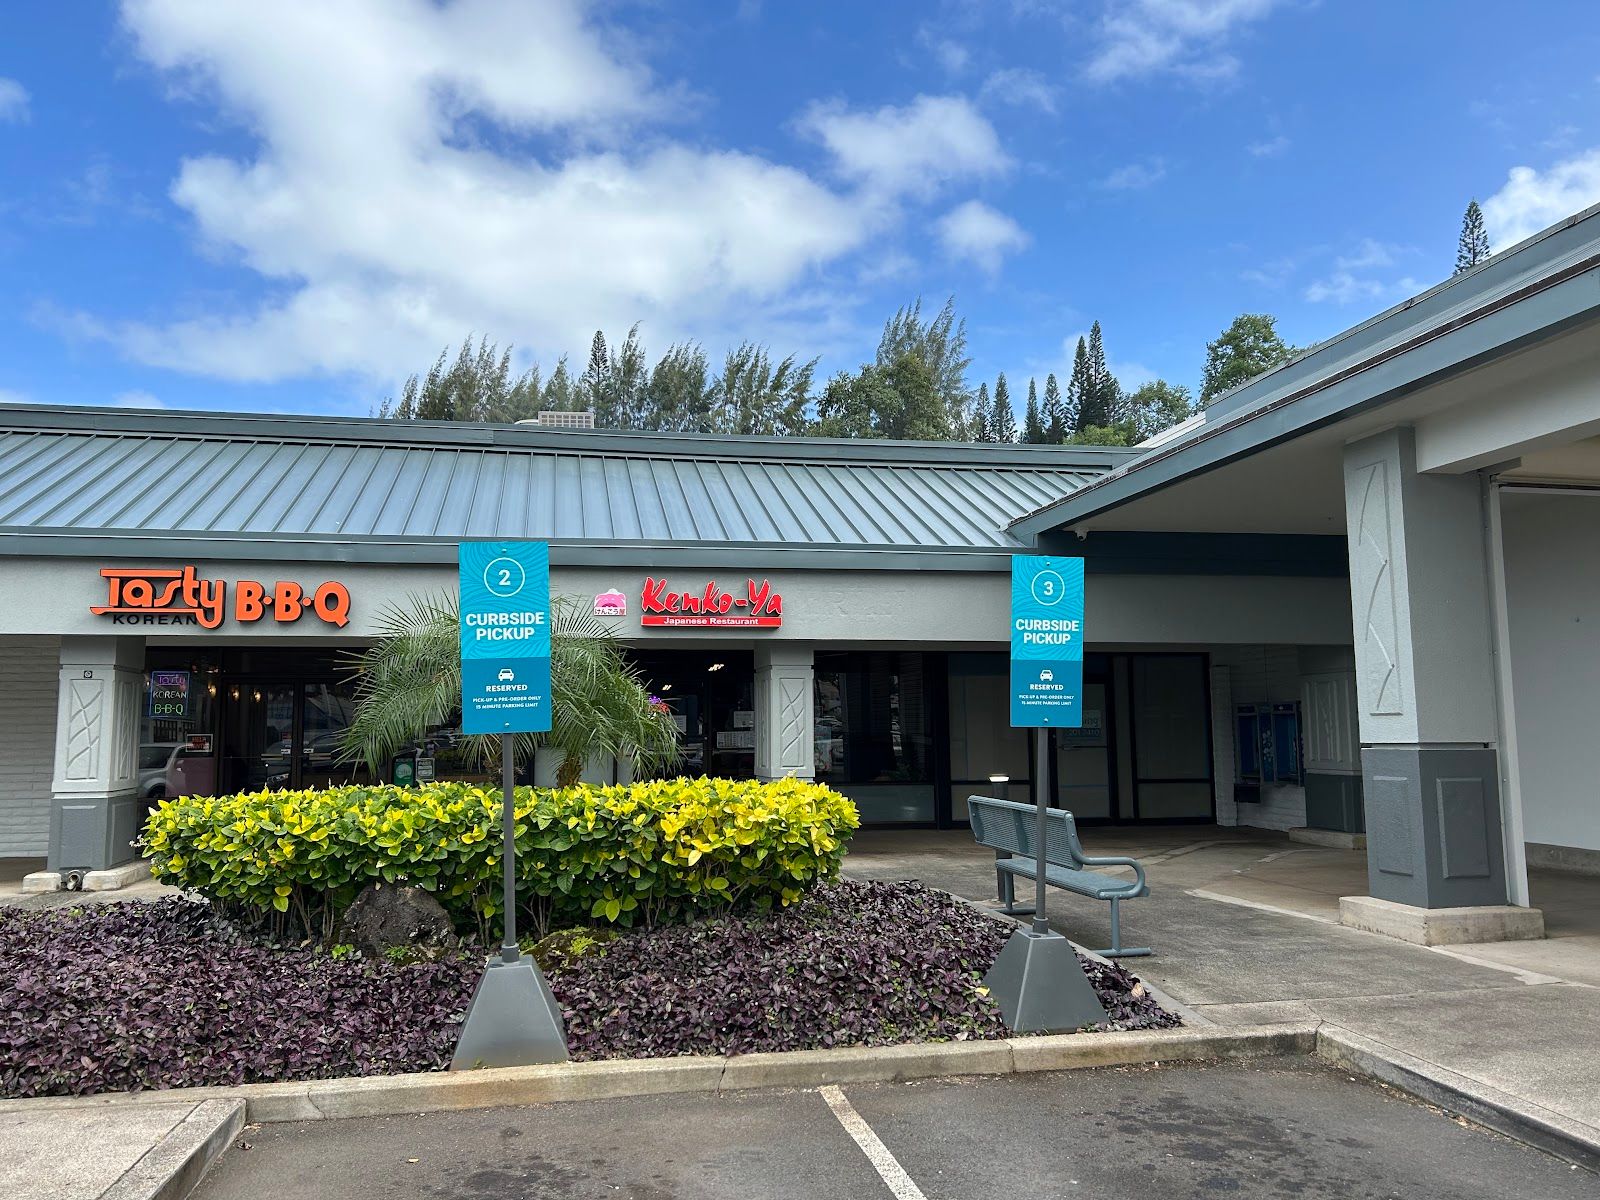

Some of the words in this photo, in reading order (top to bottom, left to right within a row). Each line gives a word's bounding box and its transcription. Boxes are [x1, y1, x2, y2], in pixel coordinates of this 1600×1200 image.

[498, 569, 511, 586] 2
[1043, 581, 1054, 596] 3
[90, 566, 225, 629] Tasty
[641, 576, 783, 615] Kenko-Ya
[112, 614, 198, 625] KOREAN
[465, 612, 544, 626] CURBSIDE
[663, 617, 708, 626] Japanese
[709, 617, 759, 625] Restaurant
[1015, 618, 1080, 632] CURBSIDE
[476, 627, 535, 640] PICKUP
[1023, 632, 1071, 645] PICKUP
[485, 684, 528, 692] RESERVED
[1029, 683, 1064, 691] RESERVED
[153, 690, 187, 699] KOREAN
